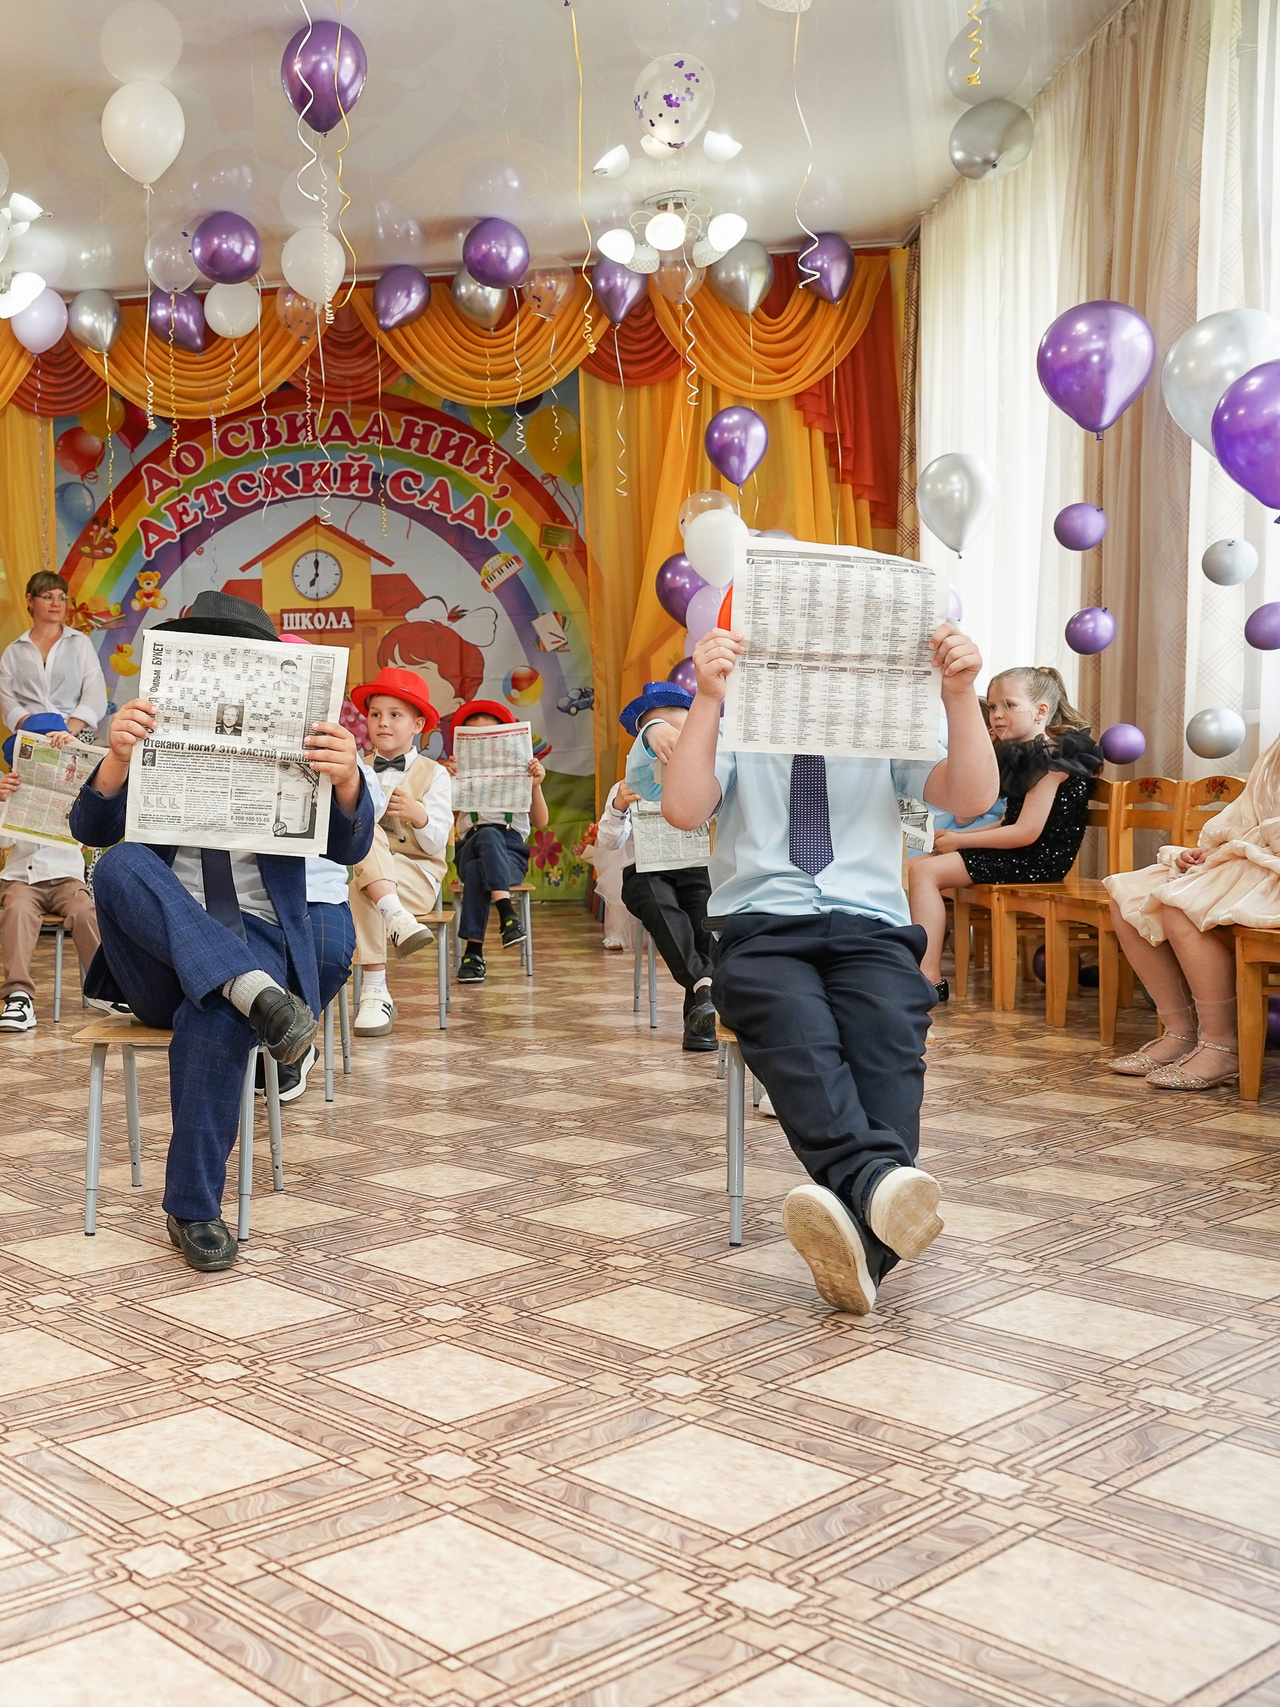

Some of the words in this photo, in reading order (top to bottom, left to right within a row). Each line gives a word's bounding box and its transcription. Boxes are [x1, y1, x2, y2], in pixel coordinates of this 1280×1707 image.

[141, 441, 206, 505] ДО
[215, 409, 512, 501] СВИДАНИЯ,
[137, 453, 375, 561] ДЕТСКИЙ
[388, 464, 515, 542] САД!
[281, 607, 354, 631] ШКОЛА
[151, 642, 164, 666] БУКЕТ
[149, 669, 161, 693] Фильм
[143, 737, 185, 751] Отекают
[188, 742, 216, 753] ноги?
[218, 745, 238, 755] ЭТО
[240, 748, 277, 760] ЗАСТОЙ
